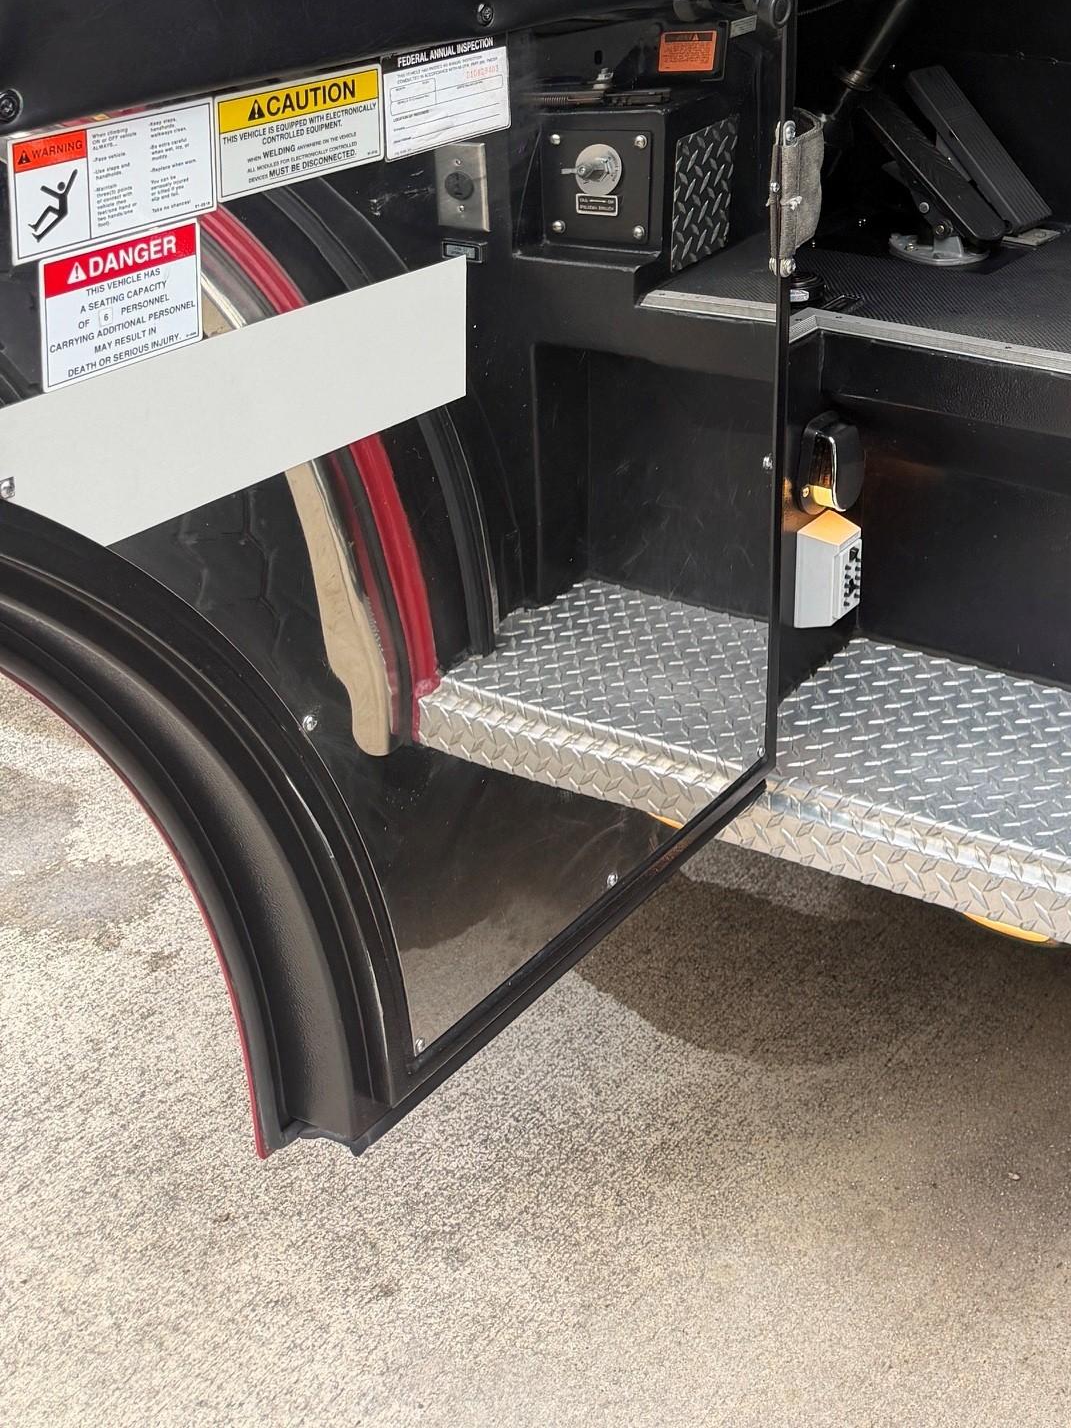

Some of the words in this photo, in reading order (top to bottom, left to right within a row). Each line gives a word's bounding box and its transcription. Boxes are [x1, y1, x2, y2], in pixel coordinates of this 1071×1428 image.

[397, 52, 430, 68] FEDERAL
[429, 46, 457, 60] ANNUAL
[457, 37, 494, 53] INSPECTION
[266, 79, 356, 117] CAUTION
[222, 135, 238, 145] THIS
[239, 128, 267, 141] VEHICLE
[268, 126, 275, 135] IS
[276, 118, 308, 134] EQUIPPED
[309, 115, 325, 126] WITH
[326, 102, 377, 121] ELECTRONICALLY
[262, 129, 305, 145] CONTROLLED
[306, 120, 343, 136] EQUIPMENT.
[31, 141, 83, 160] WARNING
[262, 144, 296, 159] WELDING
[269, 166, 289, 178] MUST
[291, 162, 300, 171] BE
[302, 149, 357, 169] DISCONNECTED.
[88, 235, 177, 278] DANGER
[80, 305, 87, 314] A
[88, 293, 125, 311] SEATING
[127, 280, 167, 299] CAPACITY
[86, 285, 105, 297] THIS
[107, 274, 142, 291] VEHICLE
[143, 267, 161, 281] HAS
[50, 333, 95, 354] CARRYING
[97, 317, 147, 338] ADDITIONAL
[148, 300, 196, 322] PERSONNEL
[78, 319, 90, 330] OF
[103, 313, 109, 322] 6
[121, 293, 170, 316] PERSONNEL
[67, 362, 97, 378] DEATH
[98, 356, 111, 368] OR
[113, 343, 150, 362] SERIOUS
[150, 333, 182, 349] INJURY.
[94, 341, 113, 354] MAY
[114, 330, 147, 347] RESULT
[149, 326, 157, 336] IN
